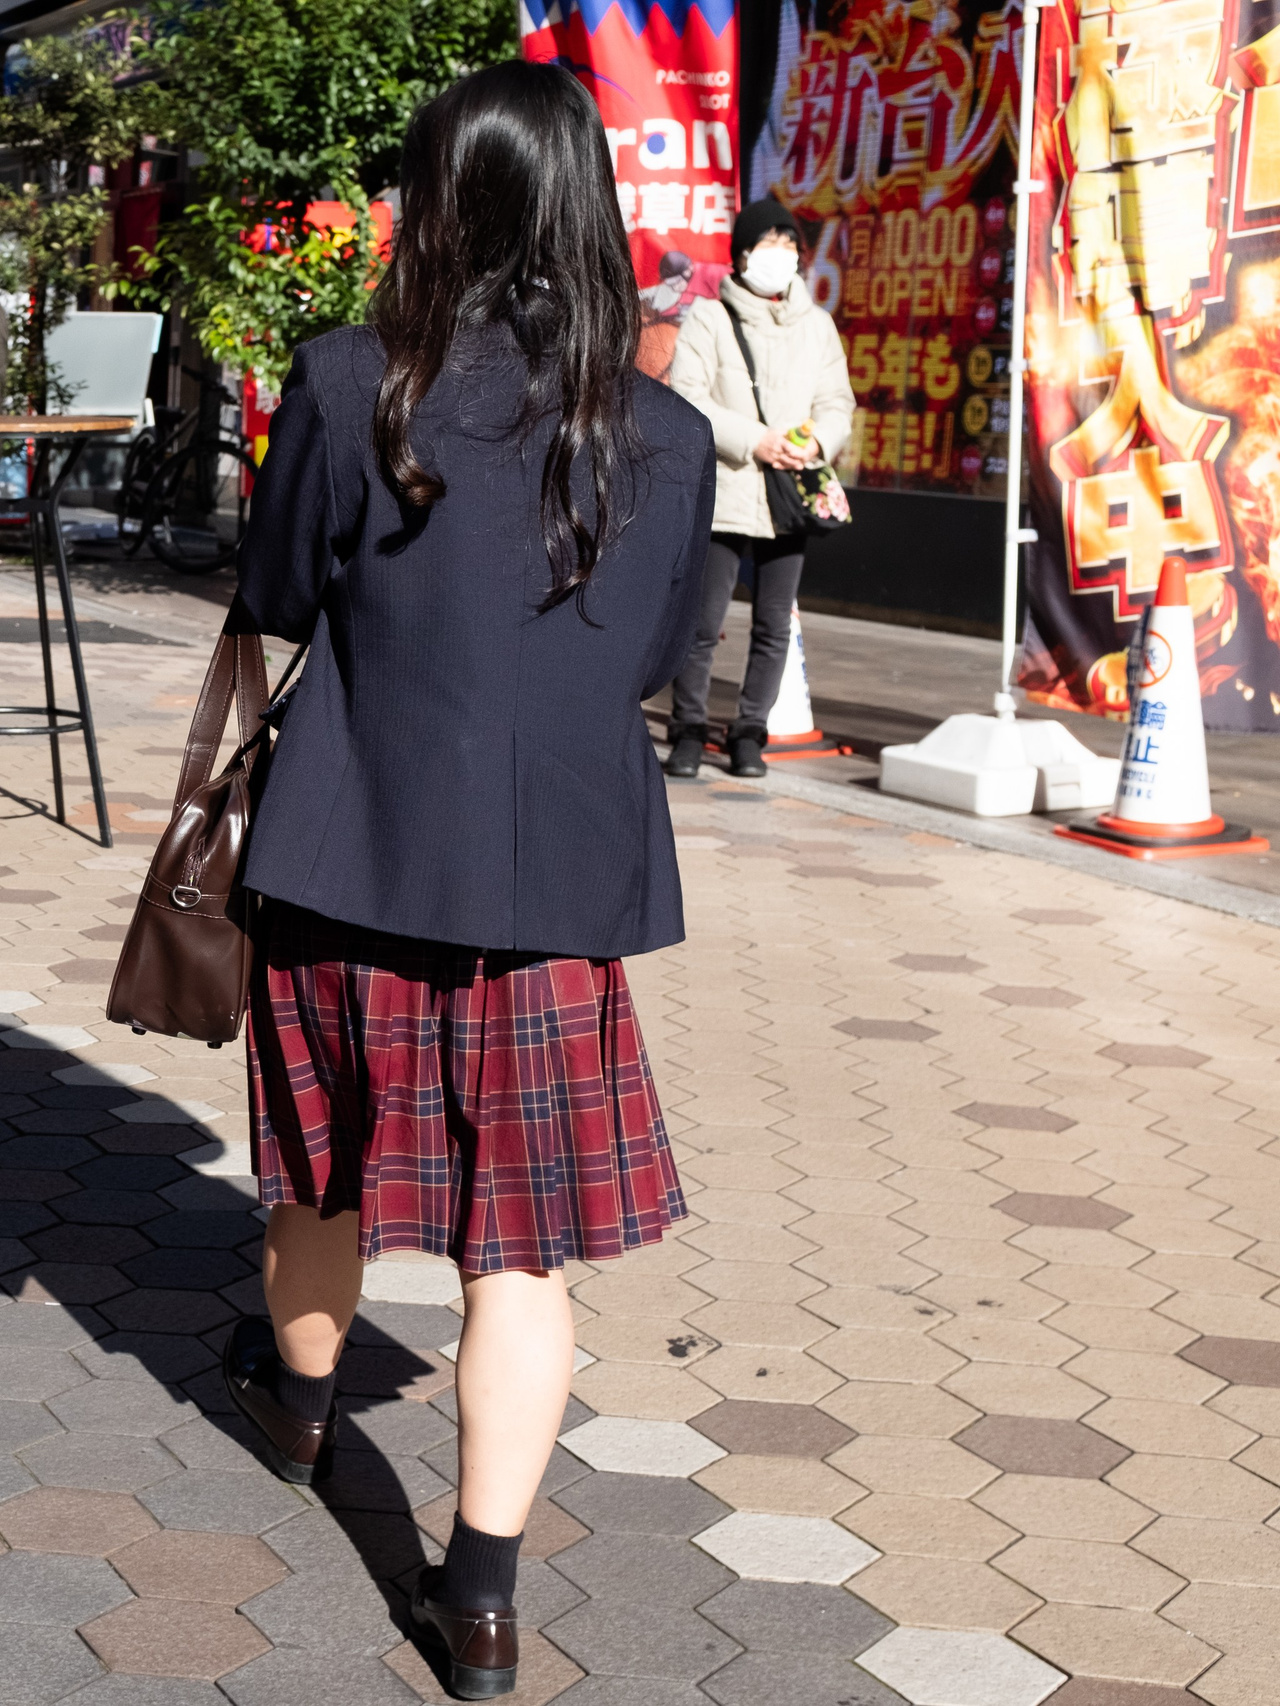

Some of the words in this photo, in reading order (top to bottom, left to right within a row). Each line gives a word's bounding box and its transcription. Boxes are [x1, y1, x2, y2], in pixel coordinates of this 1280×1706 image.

[882, 203, 977, 268] 10:00
[871, 268, 960, 316] OPEN
[840, 333, 961, 400] 5年も
